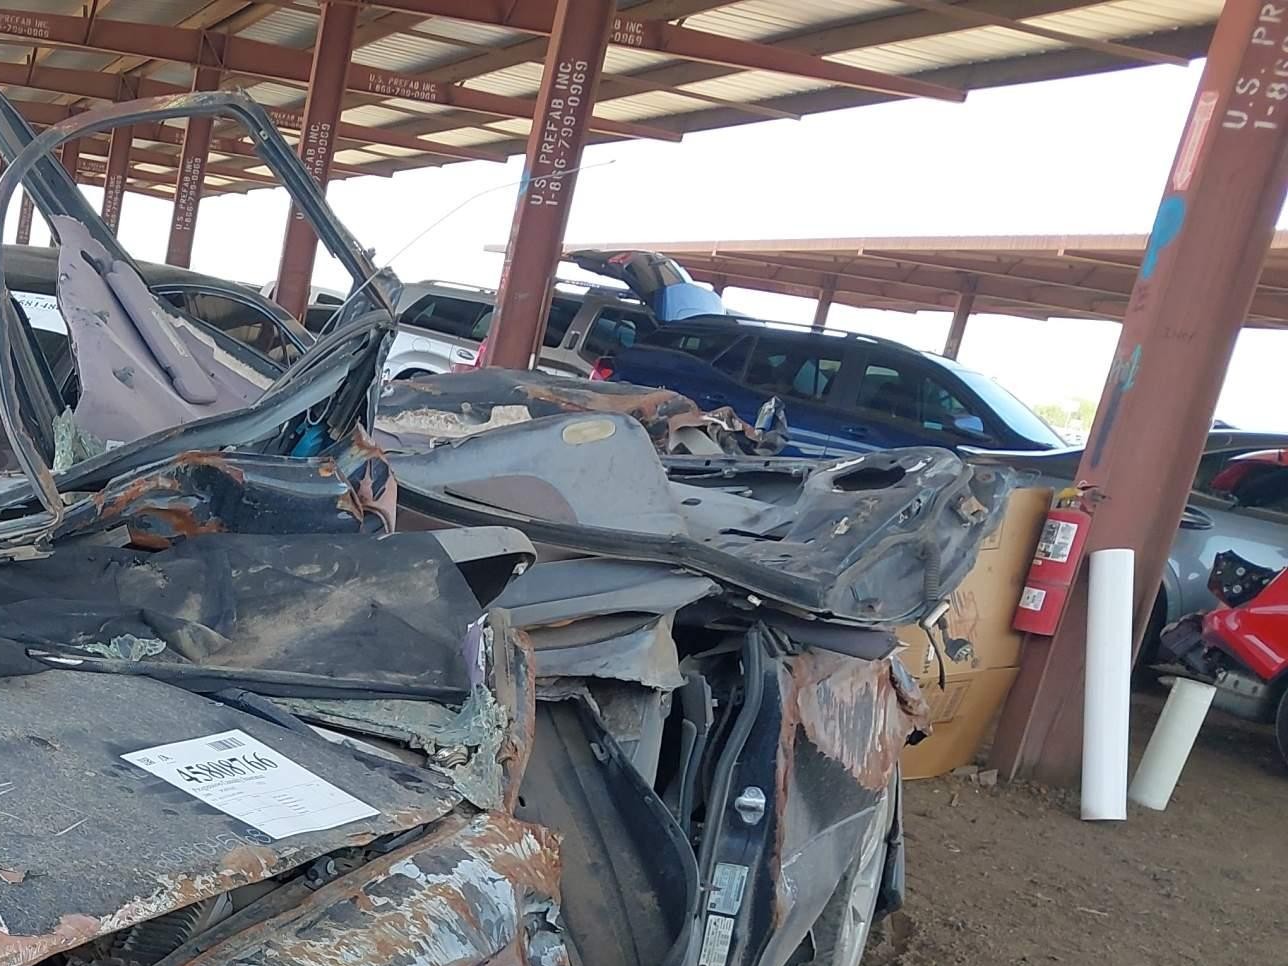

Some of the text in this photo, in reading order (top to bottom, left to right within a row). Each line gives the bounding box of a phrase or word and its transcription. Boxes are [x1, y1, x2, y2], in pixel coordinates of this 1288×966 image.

[538, 98, 565, 165] PREFAB
[545, 60, 588, 206] 1-866-799-0969
[176, 752, 279, 784] 45808766
